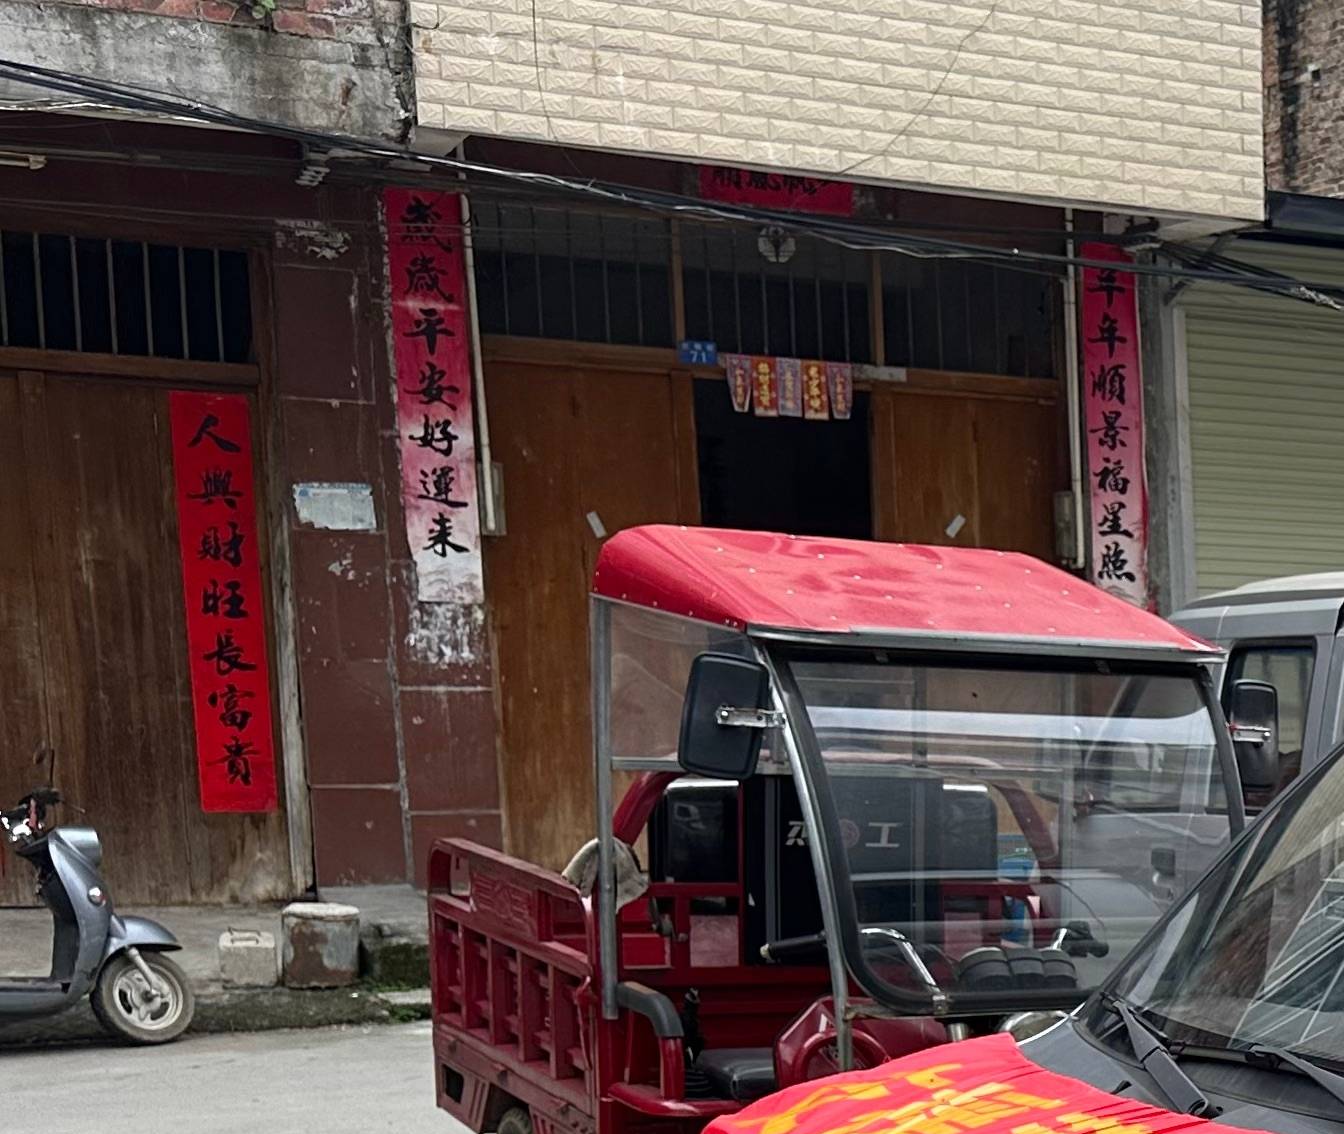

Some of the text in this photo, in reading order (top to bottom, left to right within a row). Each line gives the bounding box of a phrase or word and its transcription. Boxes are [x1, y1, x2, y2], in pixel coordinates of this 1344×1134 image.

[187, 414, 260, 786] 人興財旺長富貴
